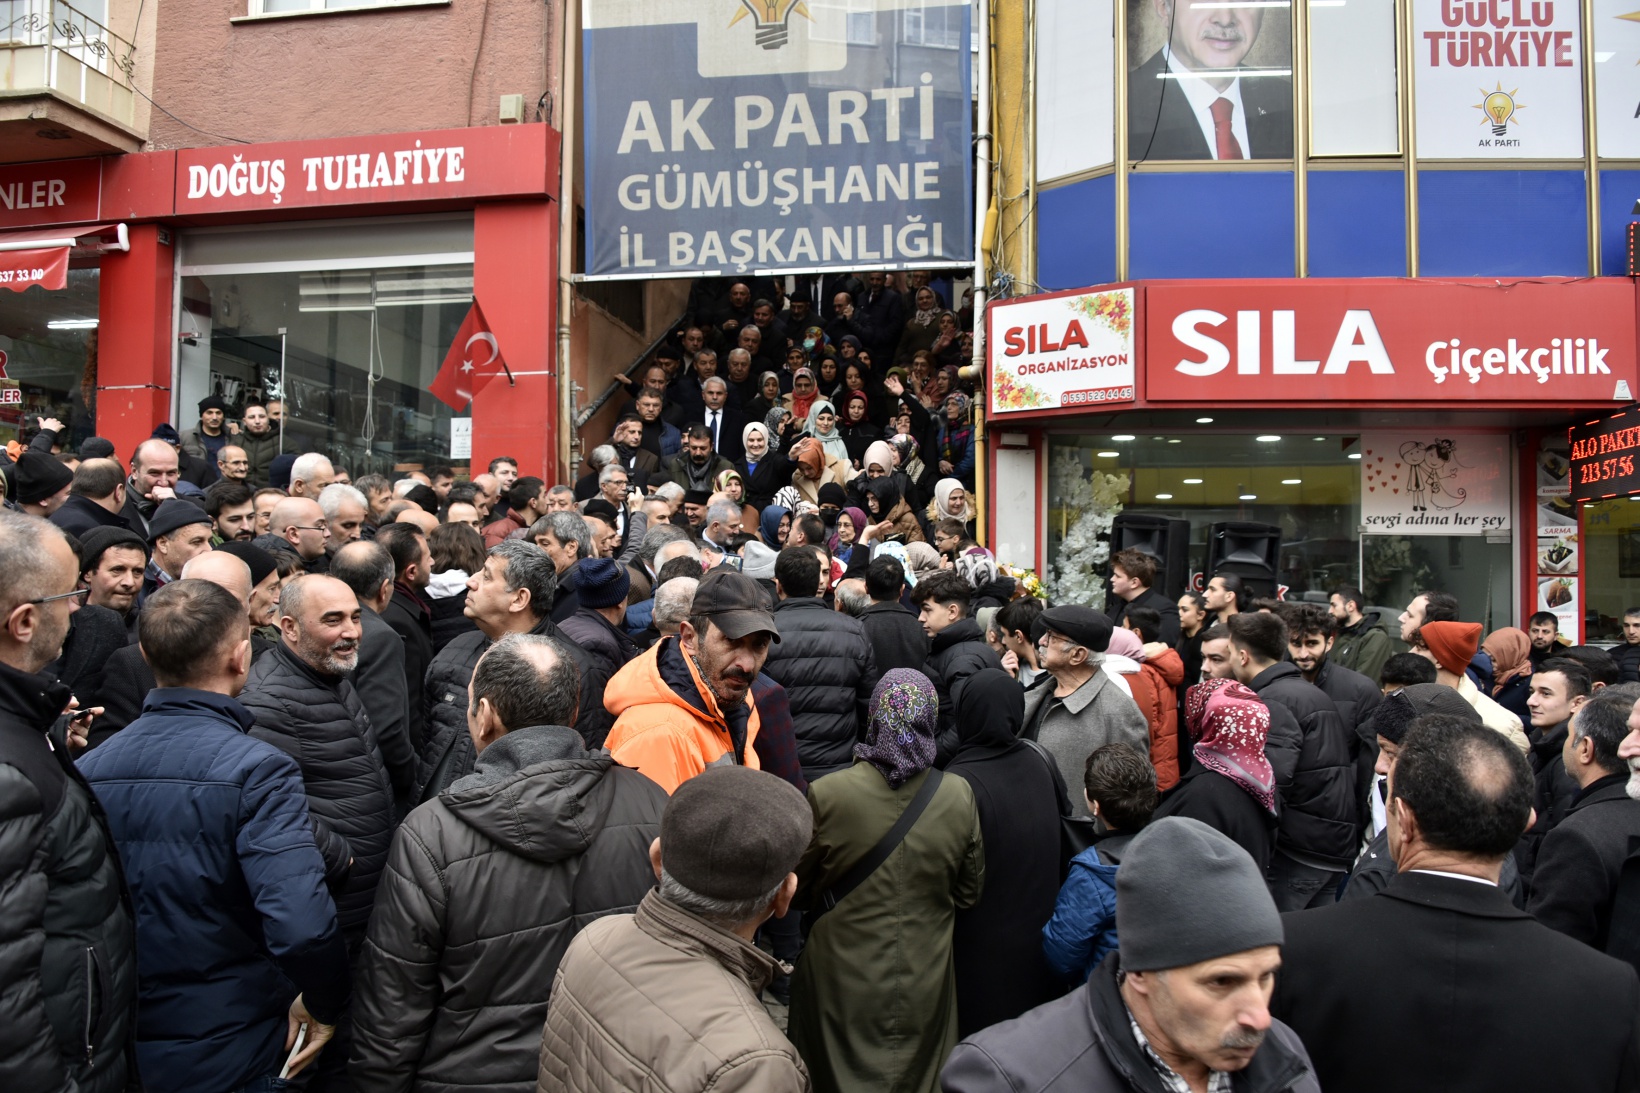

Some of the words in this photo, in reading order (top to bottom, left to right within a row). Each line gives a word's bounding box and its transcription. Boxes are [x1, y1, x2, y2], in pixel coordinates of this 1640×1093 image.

[617, 97, 715, 154] AK
[734, 72, 935, 150] PARTİ
[1478, 139, 1492, 147] AK
[187, 153, 285, 204] DOĞUŞ
[302, 139, 465, 192] TUHAFİYE
[617, 160, 941, 216] GÜMÜŞHANE
[619, 226, 656, 268] İL
[668, 214, 944, 273] BAŞKANLIĞI
[16, 269, 30, 282] 33
[31, 268, 44, 281] 00
[1004, 319, 1090, 357] SILA
[1171, 308, 1396, 377] SILA
[1425, 337, 1612, 384] Çiçekçilik
[1017, 353, 1128, 376] ORGANİZASYON
[1070, 392, 1086, 403] 553
[1088, 390, 1105, 401] 522
[1571, 437, 1598, 461] ALO
[1580, 462, 1601, 484] 213
[1602, 458, 1618, 480] 57
[1618, 455, 1635, 477] 56
[1365, 512, 1402, 529] sevgi
[1405, 512, 1449, 526] adına
[1453, 512, 1479, 526] her
[1482, 516, 1506, 530] şey
